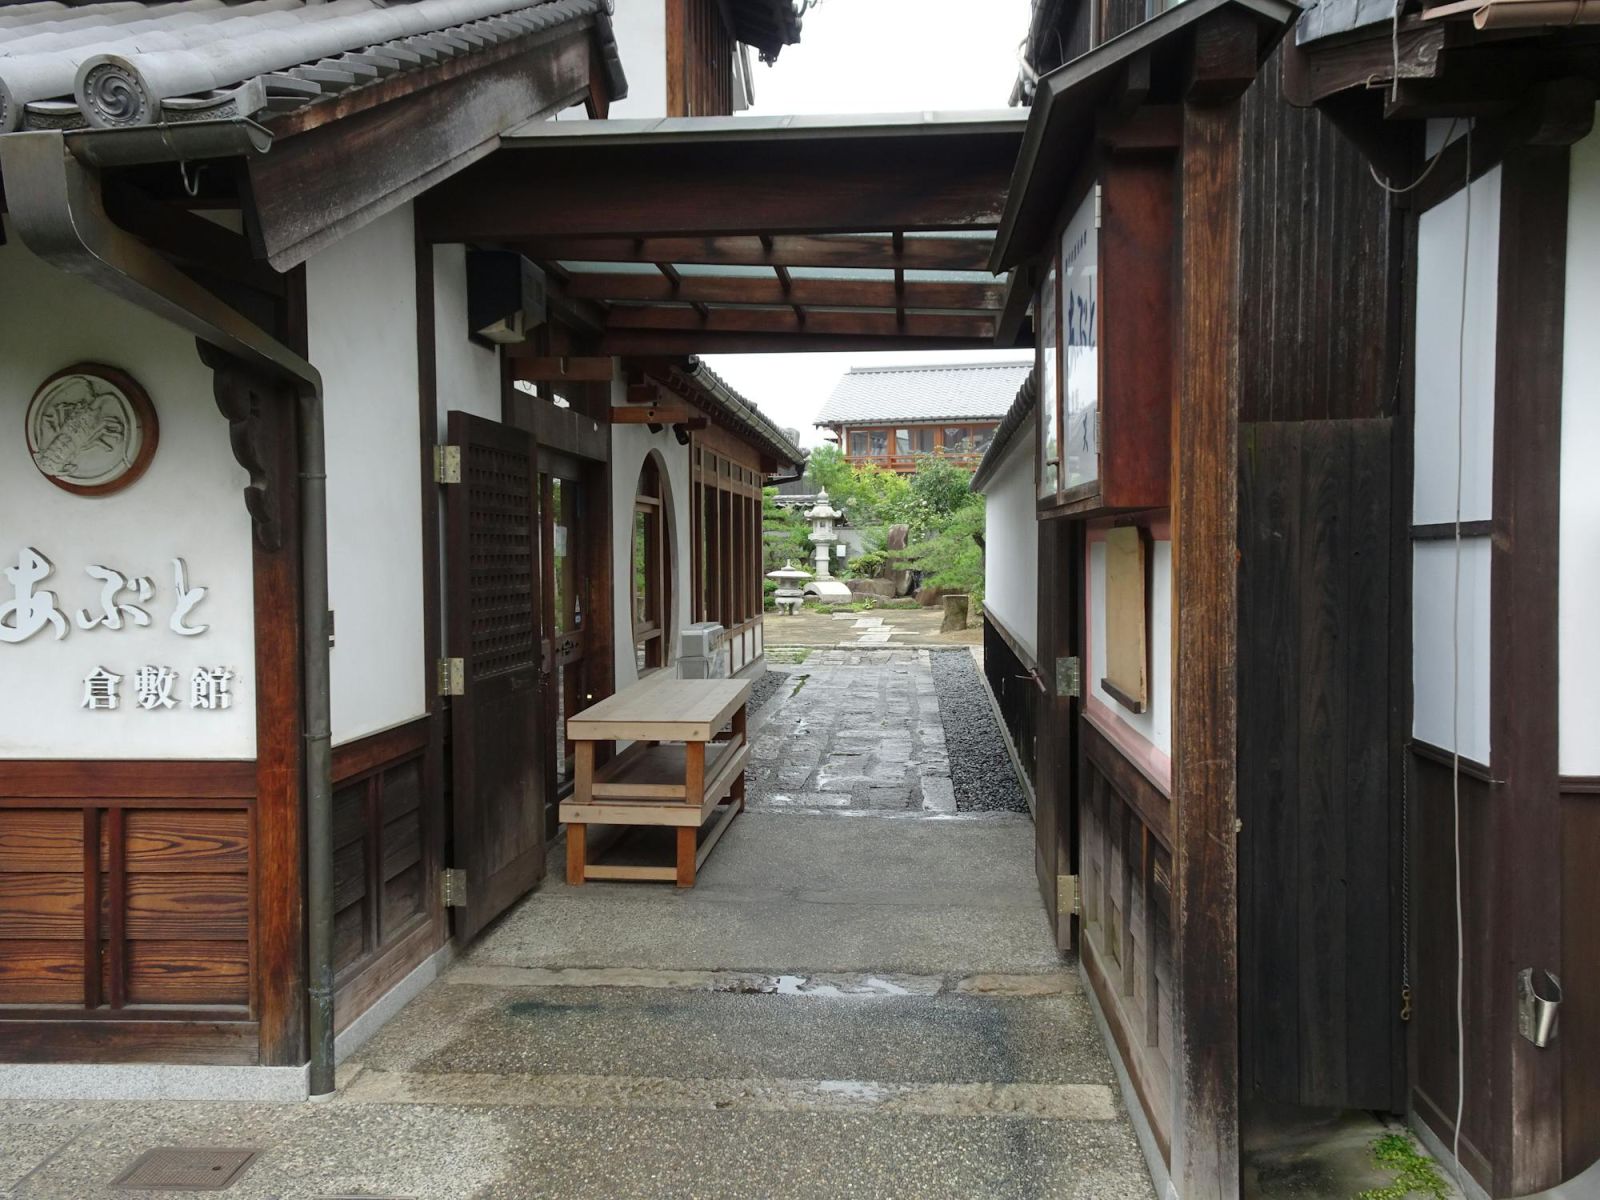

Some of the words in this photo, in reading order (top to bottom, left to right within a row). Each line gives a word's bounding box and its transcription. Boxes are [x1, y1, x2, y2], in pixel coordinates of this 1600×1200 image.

[0, 546, 209, 643] あぶと
[81, 665, 233, 710] 倉敷館
